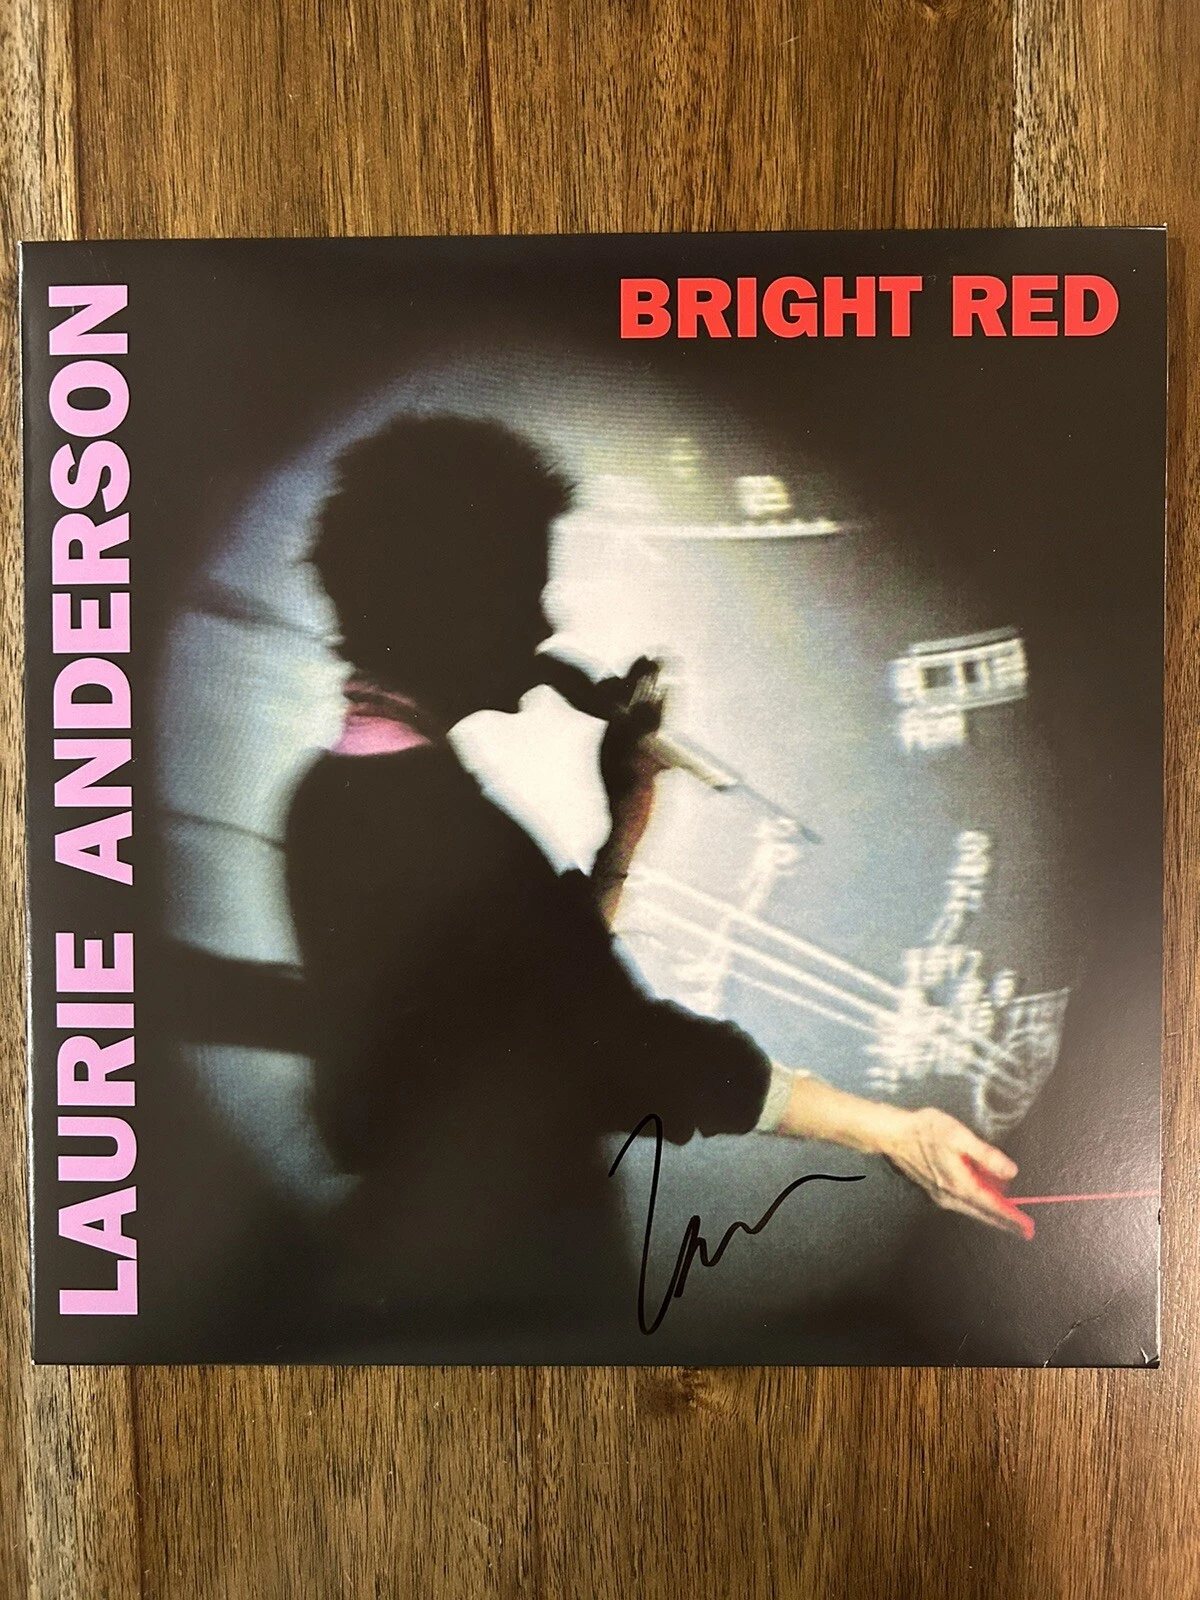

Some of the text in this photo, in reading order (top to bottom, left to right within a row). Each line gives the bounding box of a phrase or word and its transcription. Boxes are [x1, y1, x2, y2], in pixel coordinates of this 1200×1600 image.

[620, 274, 1120, 339] BRIGHT RED
[48, 284, 138, 1316] LAURIE ANDERSON
